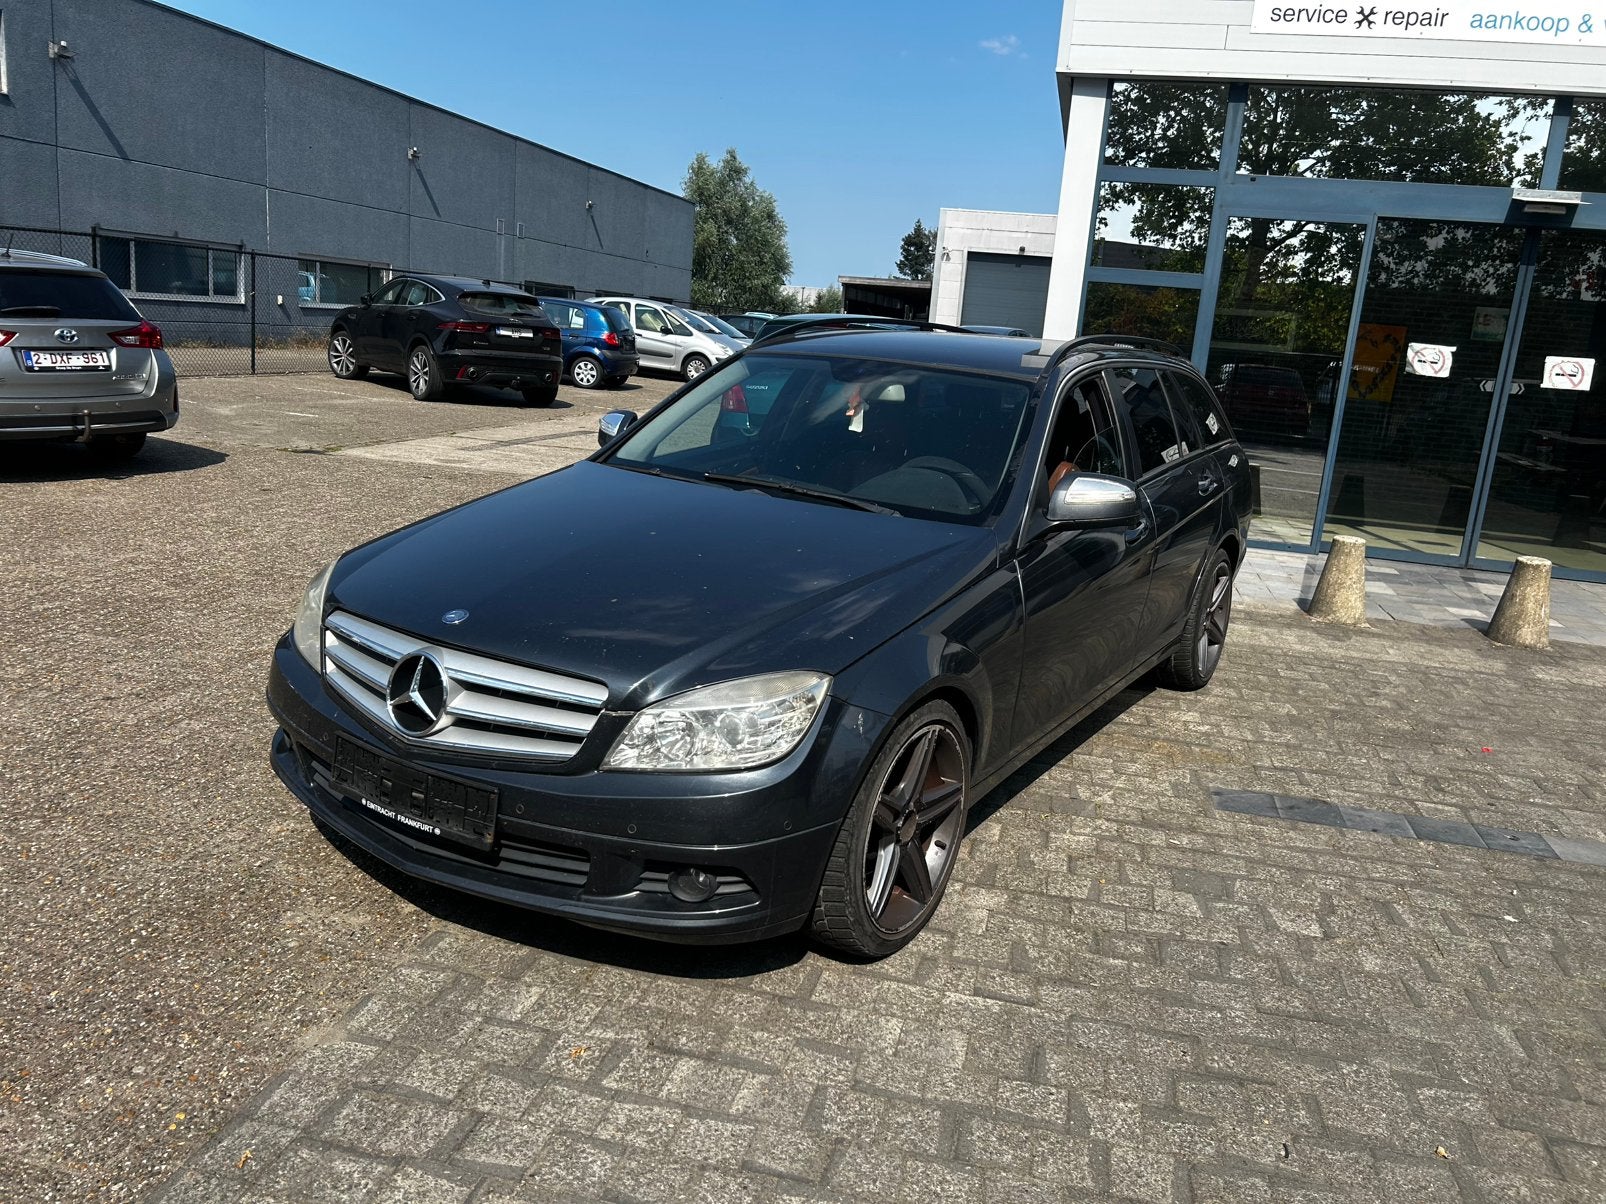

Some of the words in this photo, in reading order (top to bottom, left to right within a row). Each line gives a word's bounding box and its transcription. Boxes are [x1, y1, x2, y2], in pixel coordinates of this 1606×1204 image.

[1270, 4, 1348, 24] service
[1383, 8, 1450, 31] repair
[1470, 11, 1570, 37] aankoop
[1577, 13, 1593, 34] &
[366, 800, 396, 819] EINTRACHT
[397, 814, 434, 833] FRANKFURT
